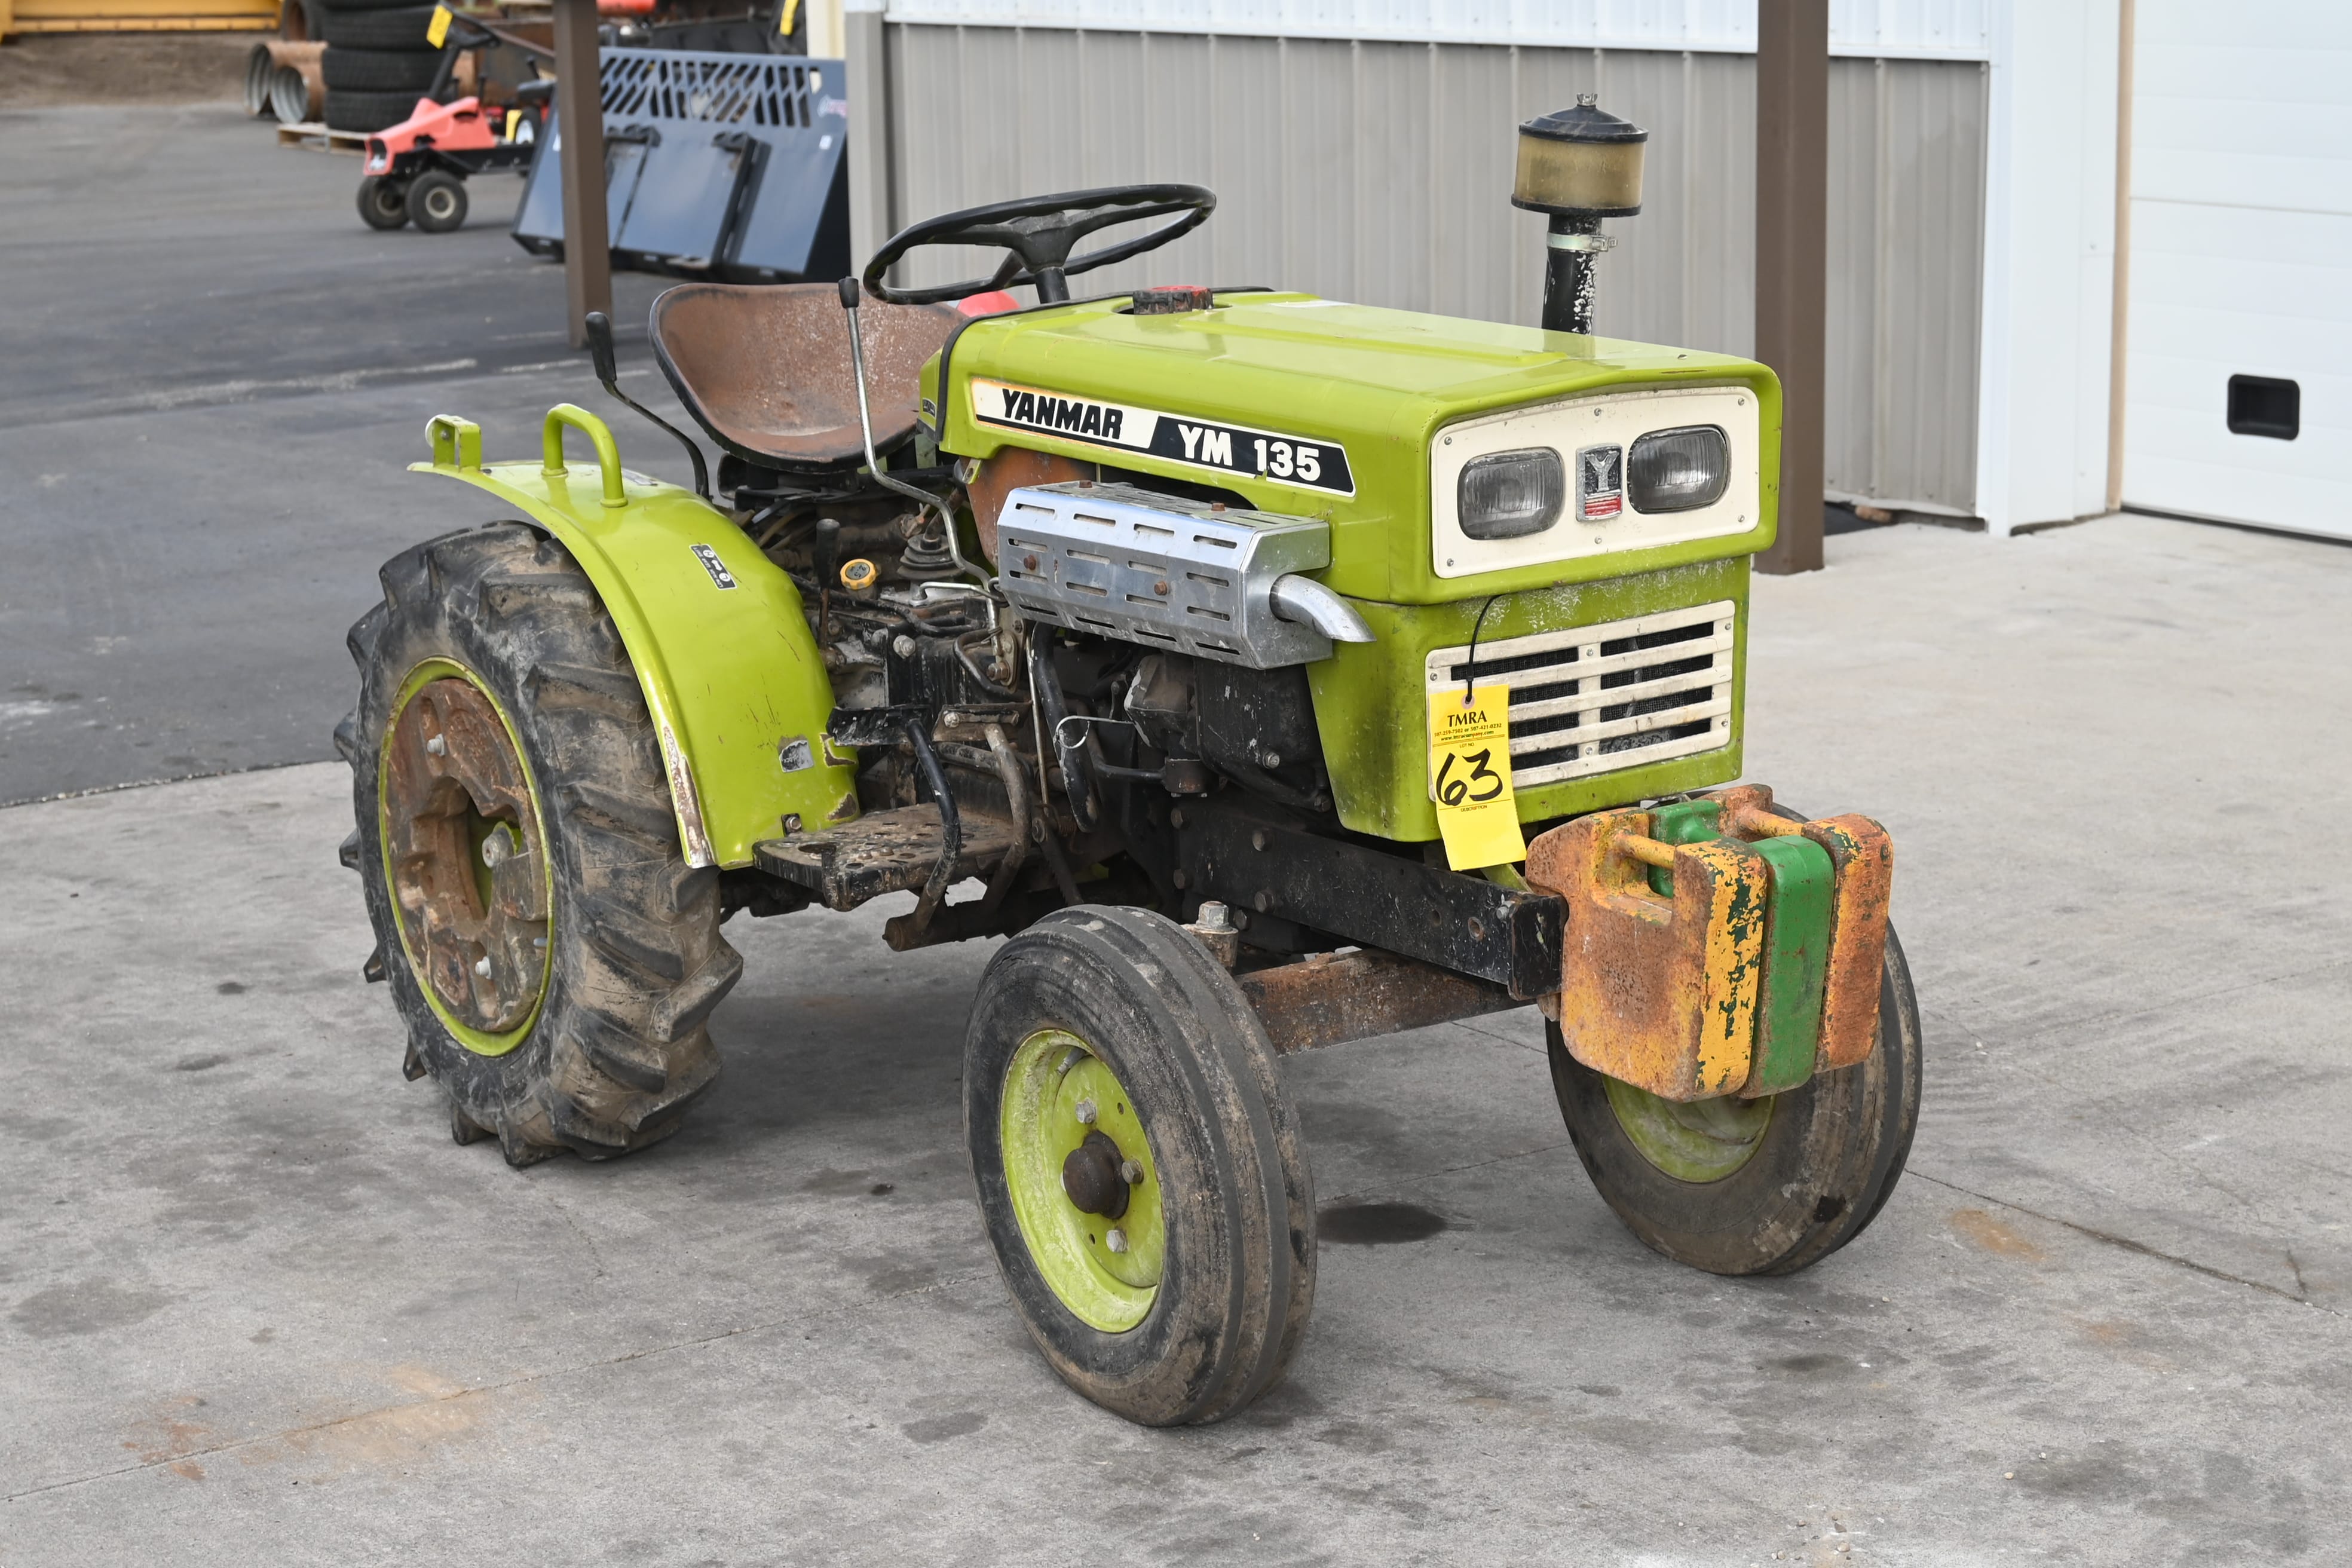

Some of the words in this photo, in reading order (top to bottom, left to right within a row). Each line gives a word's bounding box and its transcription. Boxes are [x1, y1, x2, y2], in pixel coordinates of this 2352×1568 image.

[1002, 388, 1123, 440] YANMAR
[1177, 424, 1233, 467] YM
[1254, 439, 1321, 482] 135
[1585, 450, 1620, 492] Y
[1447, 710, 1487, 727] TMRA
[1470, 723, 1502, 731] 507-421-0232
[1436, 748, 1503, 807] 63
[1460, 804, 1487, 813] DESCRIPTION
